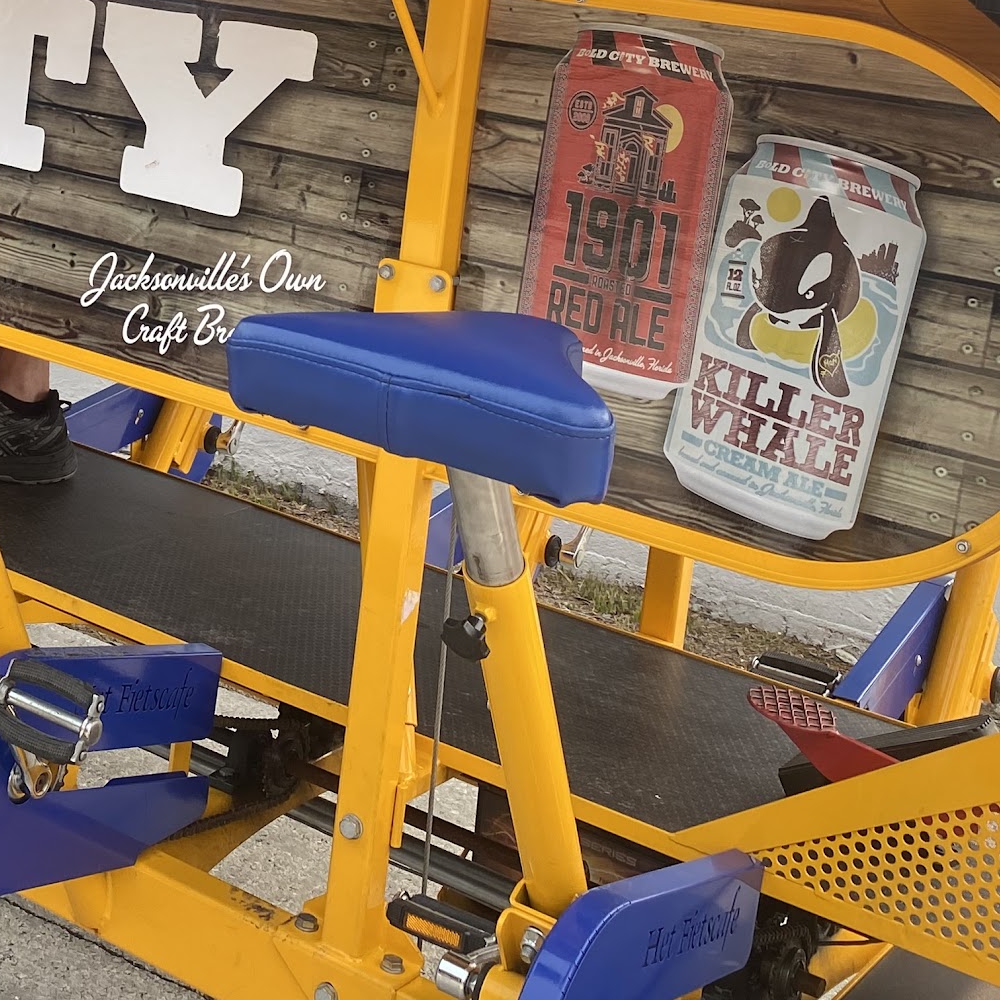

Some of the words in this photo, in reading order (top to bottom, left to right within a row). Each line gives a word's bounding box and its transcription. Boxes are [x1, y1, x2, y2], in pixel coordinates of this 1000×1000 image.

[608, 49, 646, 65] CITY
[648, 56, 713, 81] BREWERY
[838, 178, 908, 212] BREWERY
[563, 190, 680, 289] 1901
[80, 251, 253, 307] Jacksonville's
[259, 249, 327, 293] Own
[592, 275, 631, 296] ROASTED
[728, 268, 743, 281] 12
[122, 303, 188, 355] Craft
[546, 280, 604, 335] RED
[609, 298, 670, 351] ALE
[694, 352, 865, 447] KILLER
[691, 388, 858, 487] WHALE
[704, 439, 783, 483] CREAM
[783, 470, 826, 498] ALE
[115, 667, 195, 719] Fietscafe
[642, 925, 676, 968] Het
